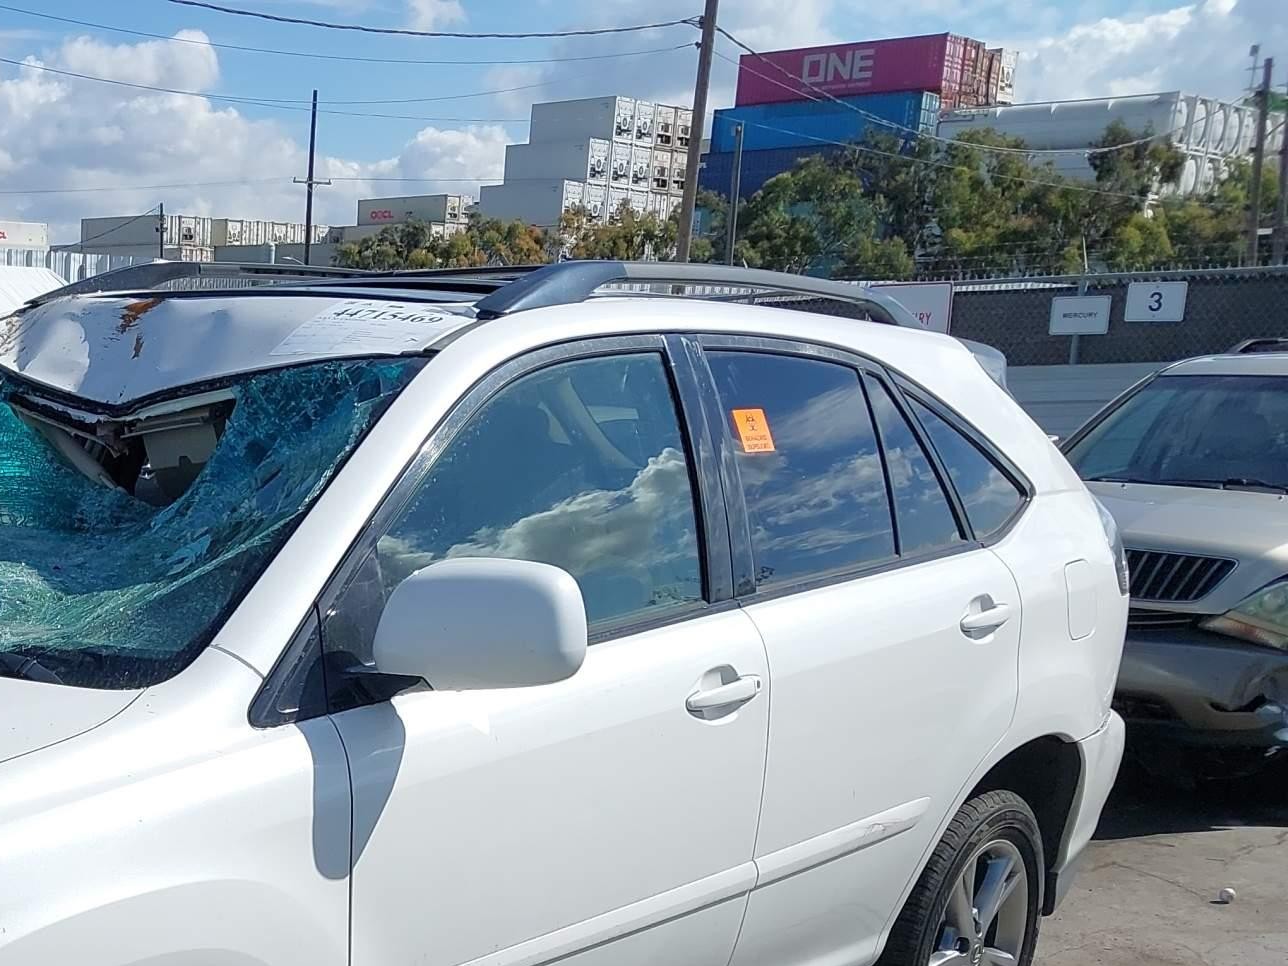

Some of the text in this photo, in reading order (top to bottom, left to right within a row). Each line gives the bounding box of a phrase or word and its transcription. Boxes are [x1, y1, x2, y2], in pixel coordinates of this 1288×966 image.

[801, 48, 875, 83] ONE
[369, 209, 394, 220] OOCL
[1148, 291, 1163, 312] 3
[333, 307, 444, 324] 44715469
